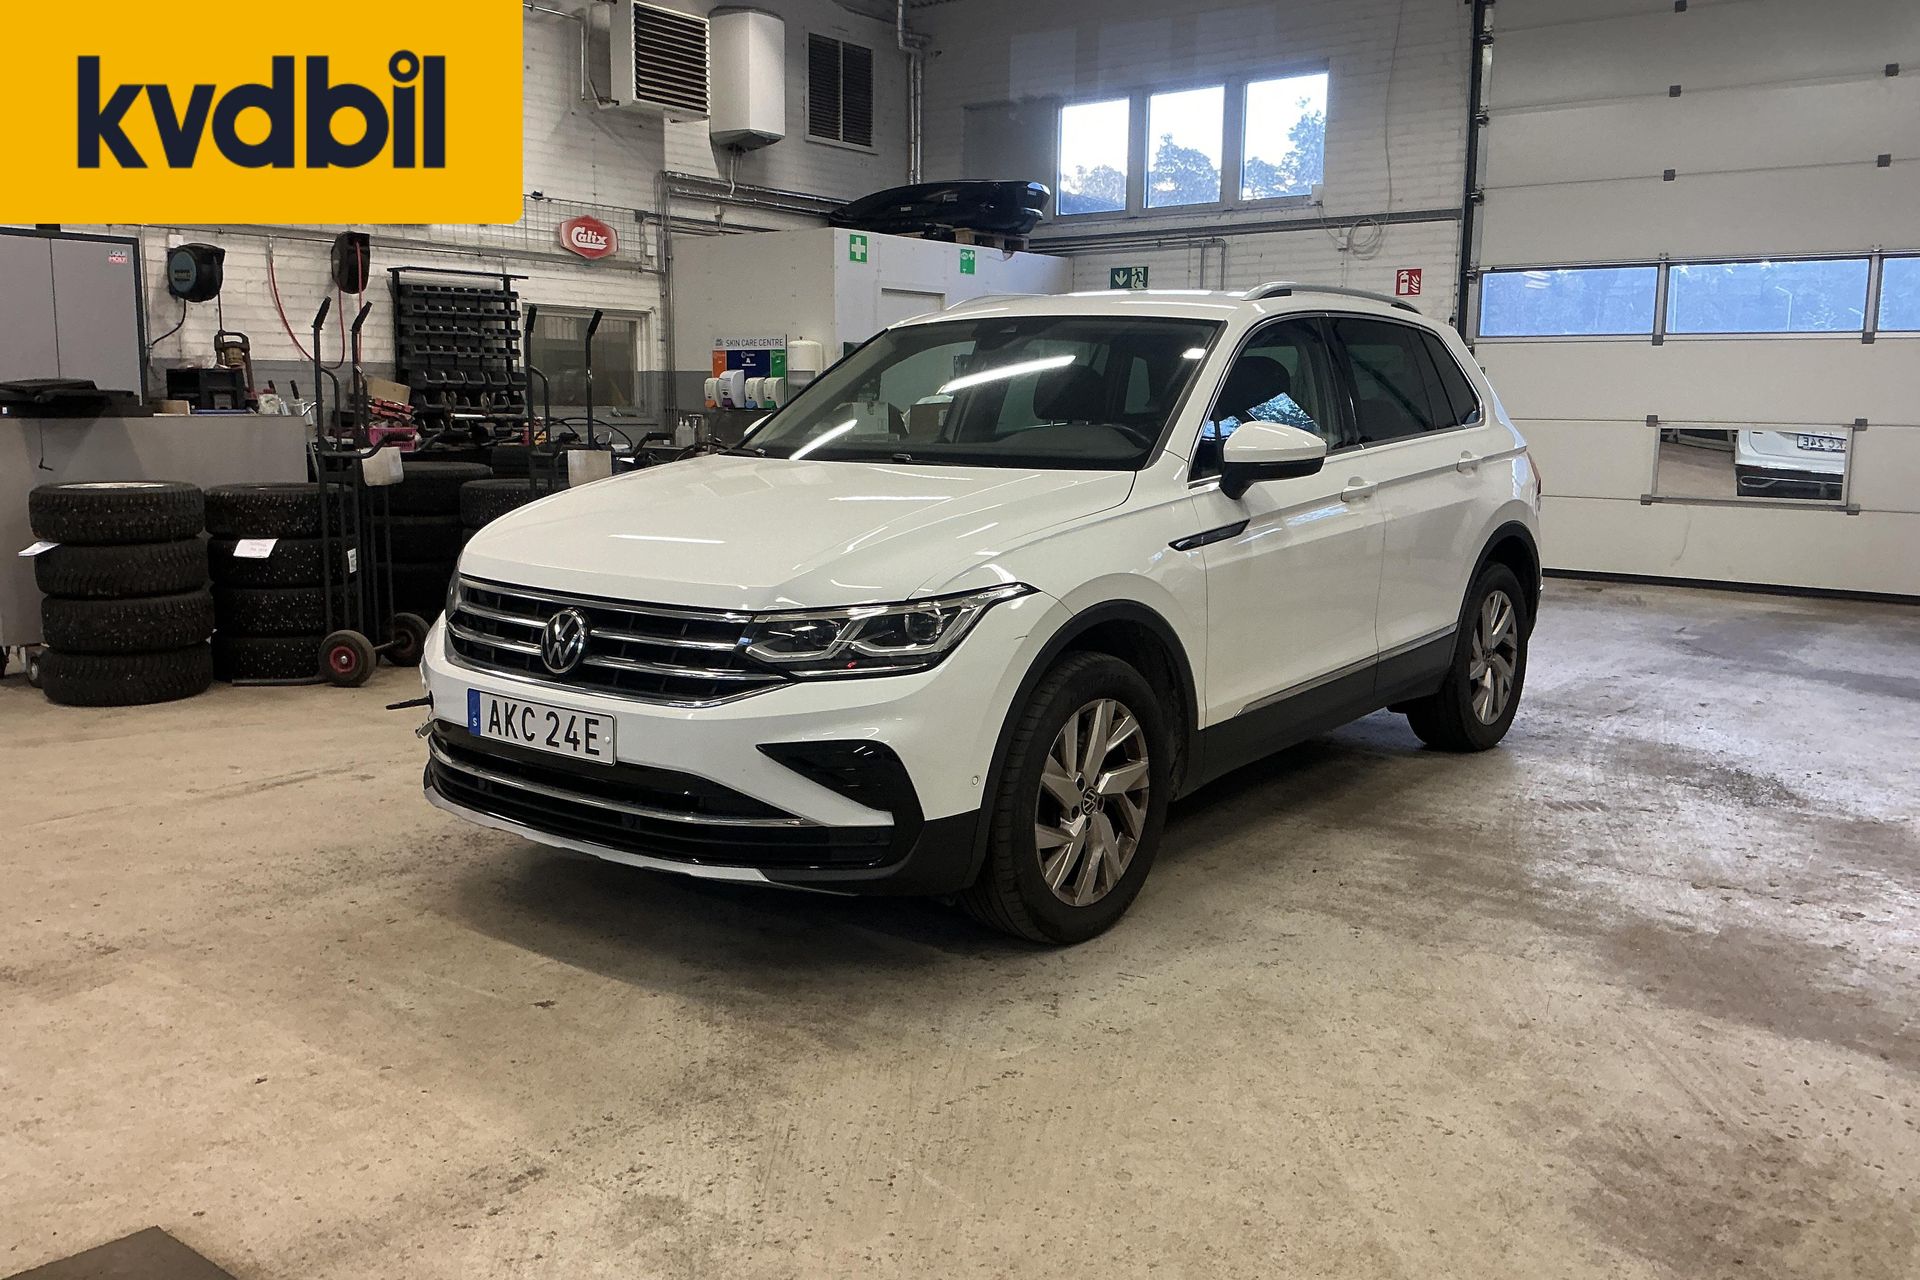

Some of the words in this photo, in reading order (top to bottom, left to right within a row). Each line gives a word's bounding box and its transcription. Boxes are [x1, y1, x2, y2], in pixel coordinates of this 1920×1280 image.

[571, 226, 609, 250] Calix
[726, 339, 740, 347] SKIN
[741, 339, 757, 347] CARE
[758, 338, 784, 347] CENTRE
[488, 699, 536, 742] AKC
[545, 711, 600, 756] 24E
